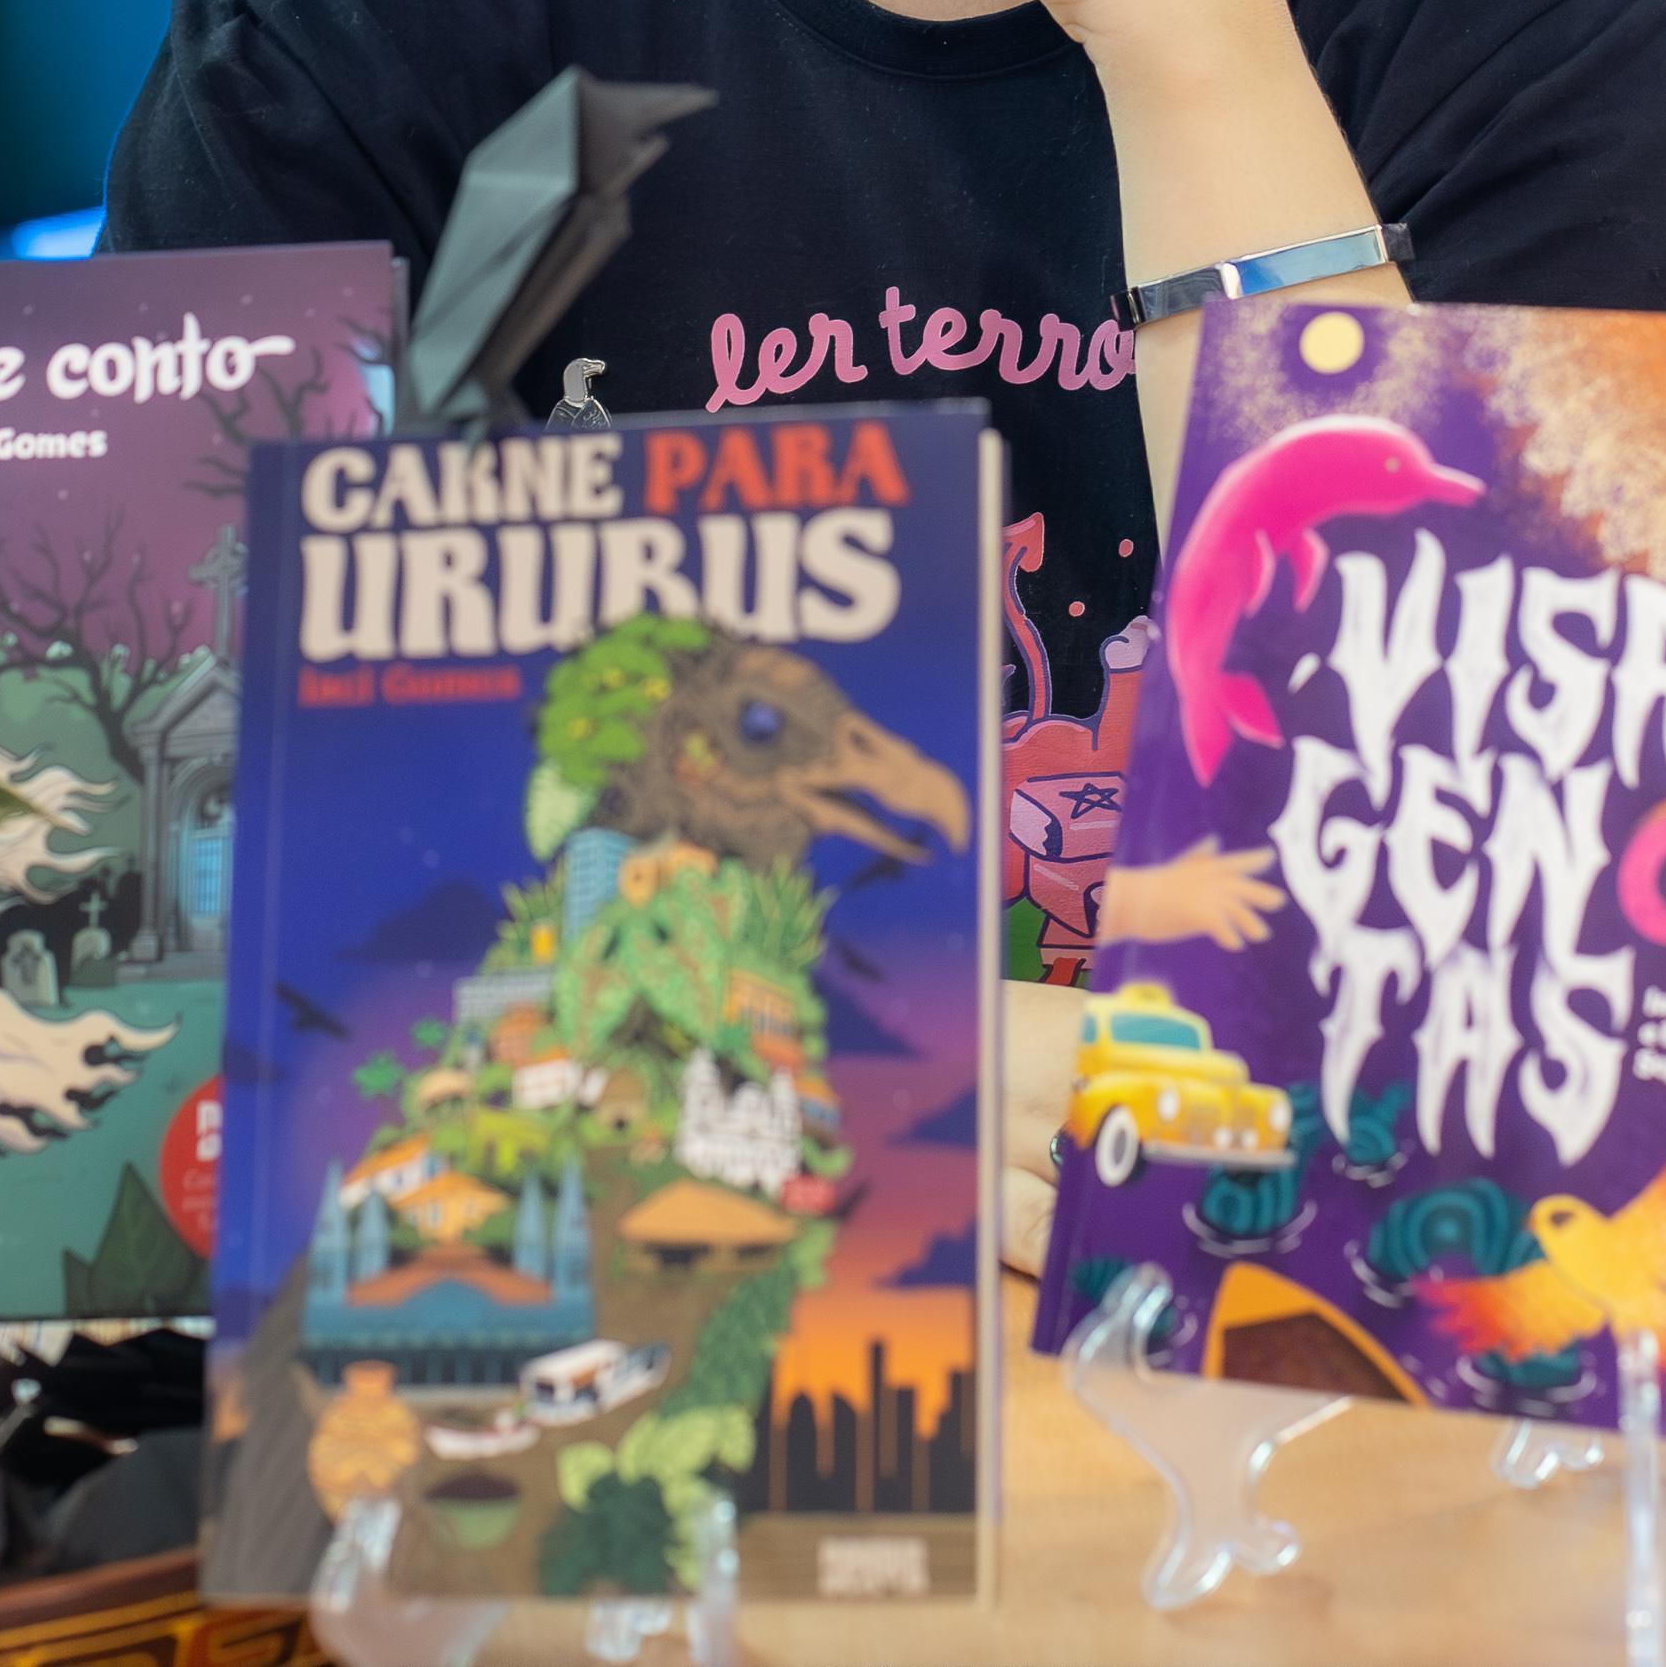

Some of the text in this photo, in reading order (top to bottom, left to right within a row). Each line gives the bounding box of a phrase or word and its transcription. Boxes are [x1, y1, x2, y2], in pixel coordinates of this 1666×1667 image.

[46, 312, 296, 404] conto
[705, 286, 1137, 414] ler terro
[301, 420, 910, 534] CARNE PARA
[299, 506, 903, 664] URUBUS
[1267, 735, 1611, 968] GEN
[1309, 926, 1636, 1167] TAS
